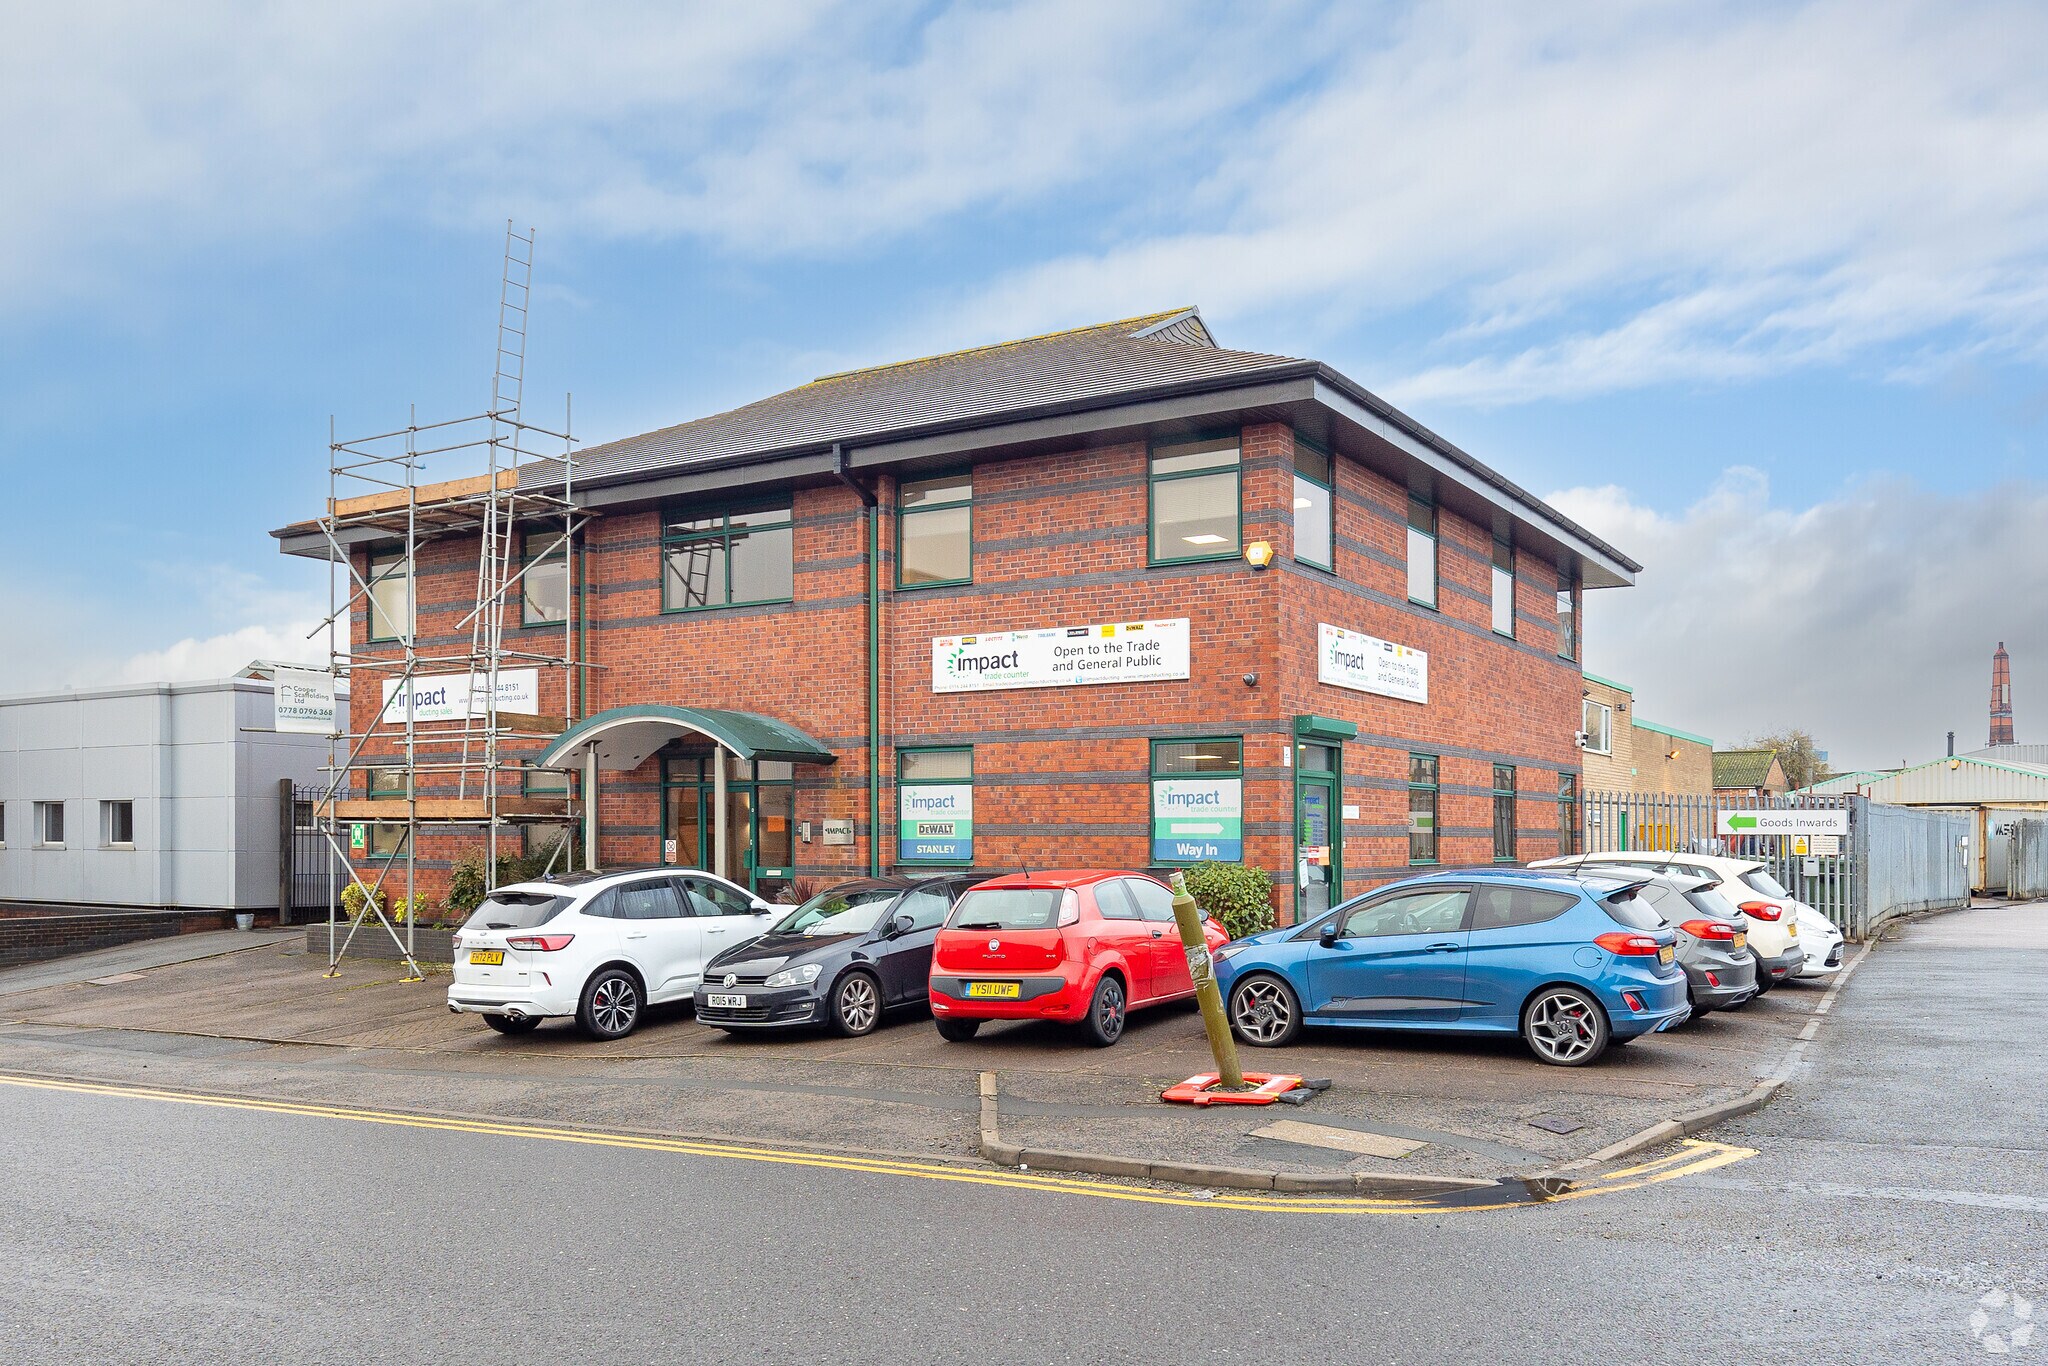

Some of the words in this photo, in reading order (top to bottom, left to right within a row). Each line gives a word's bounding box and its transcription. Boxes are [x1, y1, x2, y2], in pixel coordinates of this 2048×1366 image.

[1054, 646, 1084, 658] Open
[1088, 646, 1100, 654] to
[1104, 642, 1122, 654] the
[1127, 640, 1160, 652] Trade
[958, 650, 1018, 674] impact
[1052, 660, 1074, 672] and
[1078, 657, 1122, 670] General
[1126, 654, 1162, 667] Public
[1334, 650, 1364, 670] impact
[1378, 656, 1390, 670] Open
[1392, 662, 1397, 670] to
[1398, 662, 1406, 673] the
[1406, 663, 1418, 676] Trade
[504, 683, 519, 692] 8151
[1378, 672, 1387, 682] and
[1388, 672, 1405, 686] General
[1406, 677, 1420, 690] Public
[294, 692, 330, 701] Scaffolding
[419, 708, 439, 717] ducting
[440, 708, 453, 716] sales
[912, 794, 955, 811] impact
[1168, 790, 1220, 808] impact
[1760, 818, 1792, 828] Goods
[1796, 818, 1838, 828] Inwards
[916, 845, 956, 854] STANLEY
[1176, 842, 1204, 858] Way
[1206, 843, 1218, 856] In
[976, 984, 992, 994] YS11
[994, 984, 1013, 994] UWF
[728, 996, 742, 1006] WRJ
